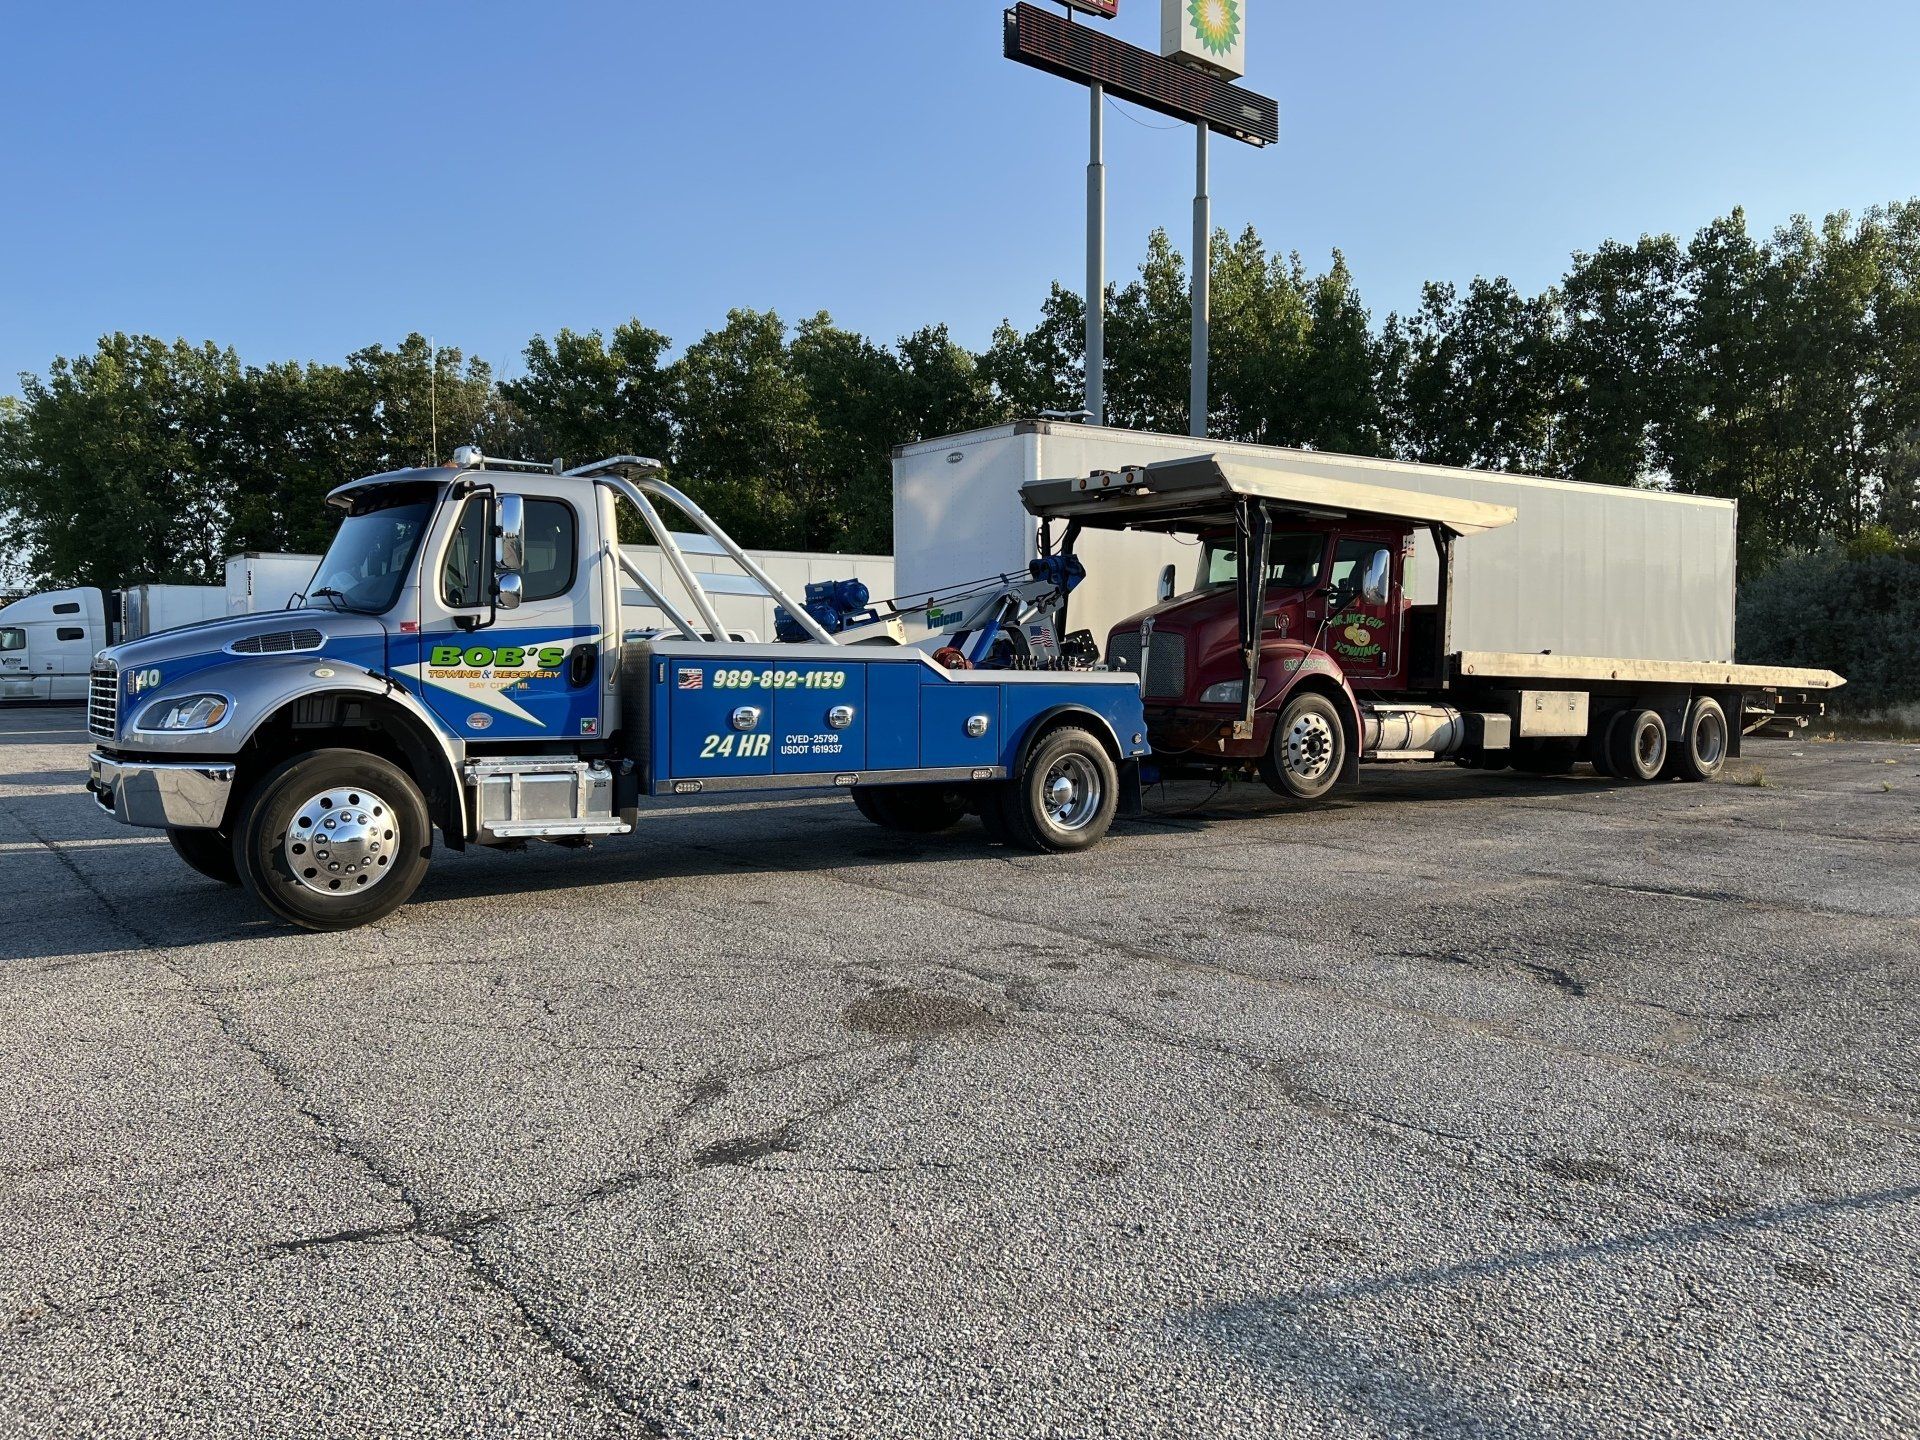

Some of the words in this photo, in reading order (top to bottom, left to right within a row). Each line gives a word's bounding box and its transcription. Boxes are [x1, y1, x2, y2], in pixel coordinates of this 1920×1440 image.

[1346, 613, 1367, 625] NICE
[1366, 616, 1386, 630] GUY
[429, 645, 566, 668] BOB'S
[1333, 640, 1381, 657] TOWING
[428, 669, 481, 679] TOWING
[481, 669, 491, 679] &
[492, 670, 561, 679] RECOVERY
[712, 669, 846, 689] 989-892-1139
[468, 682, 486, 690] BAY
[699, 734, 736, 759] 24
[736, 733, 772, 758] HR
[785, 734, 839, 744] CVED-25799
[780, 745, 809, 755] USDOT
[811, 744, 843, 755] 1619337
